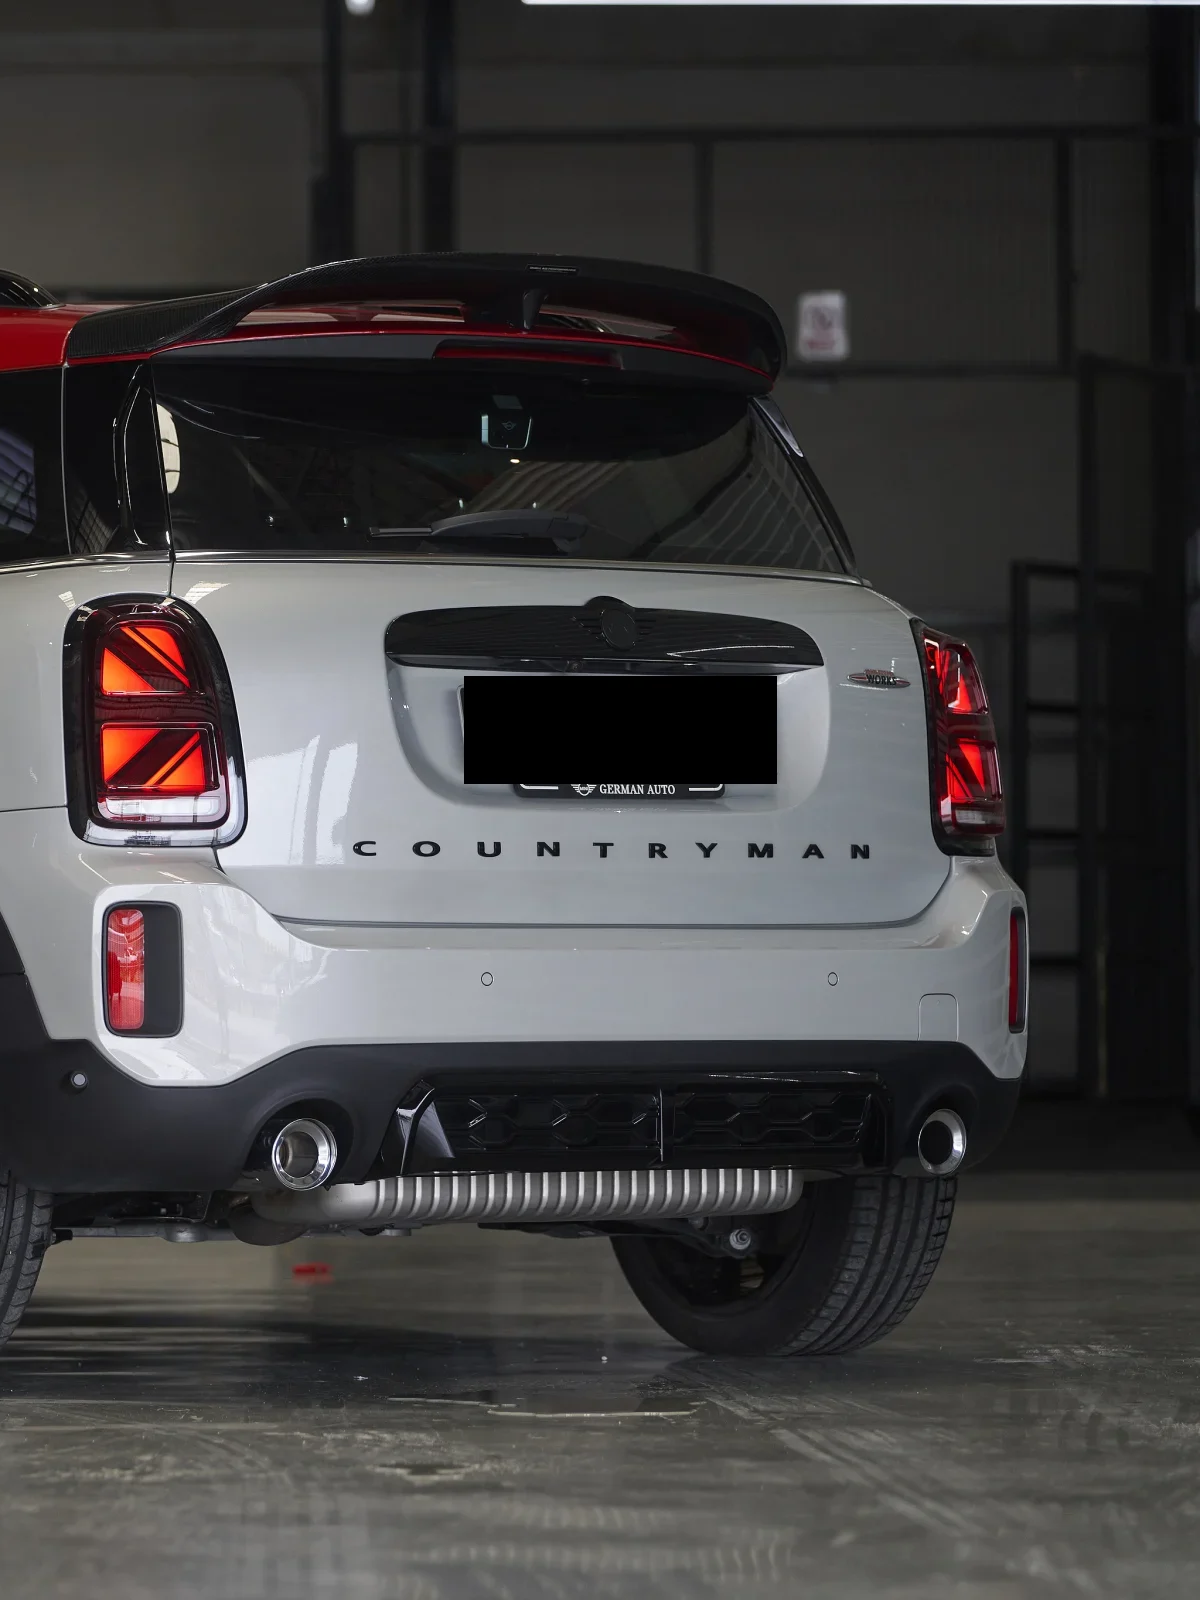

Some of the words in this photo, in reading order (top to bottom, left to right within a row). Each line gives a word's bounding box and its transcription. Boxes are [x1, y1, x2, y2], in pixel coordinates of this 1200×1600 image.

[866, 674, 897, 686] WORKS
[599, 784, 646, 795] GERMAN
[647, 784, 676, 795] AUTO
[352, 840, 870, 860] COUNTRYMAN
